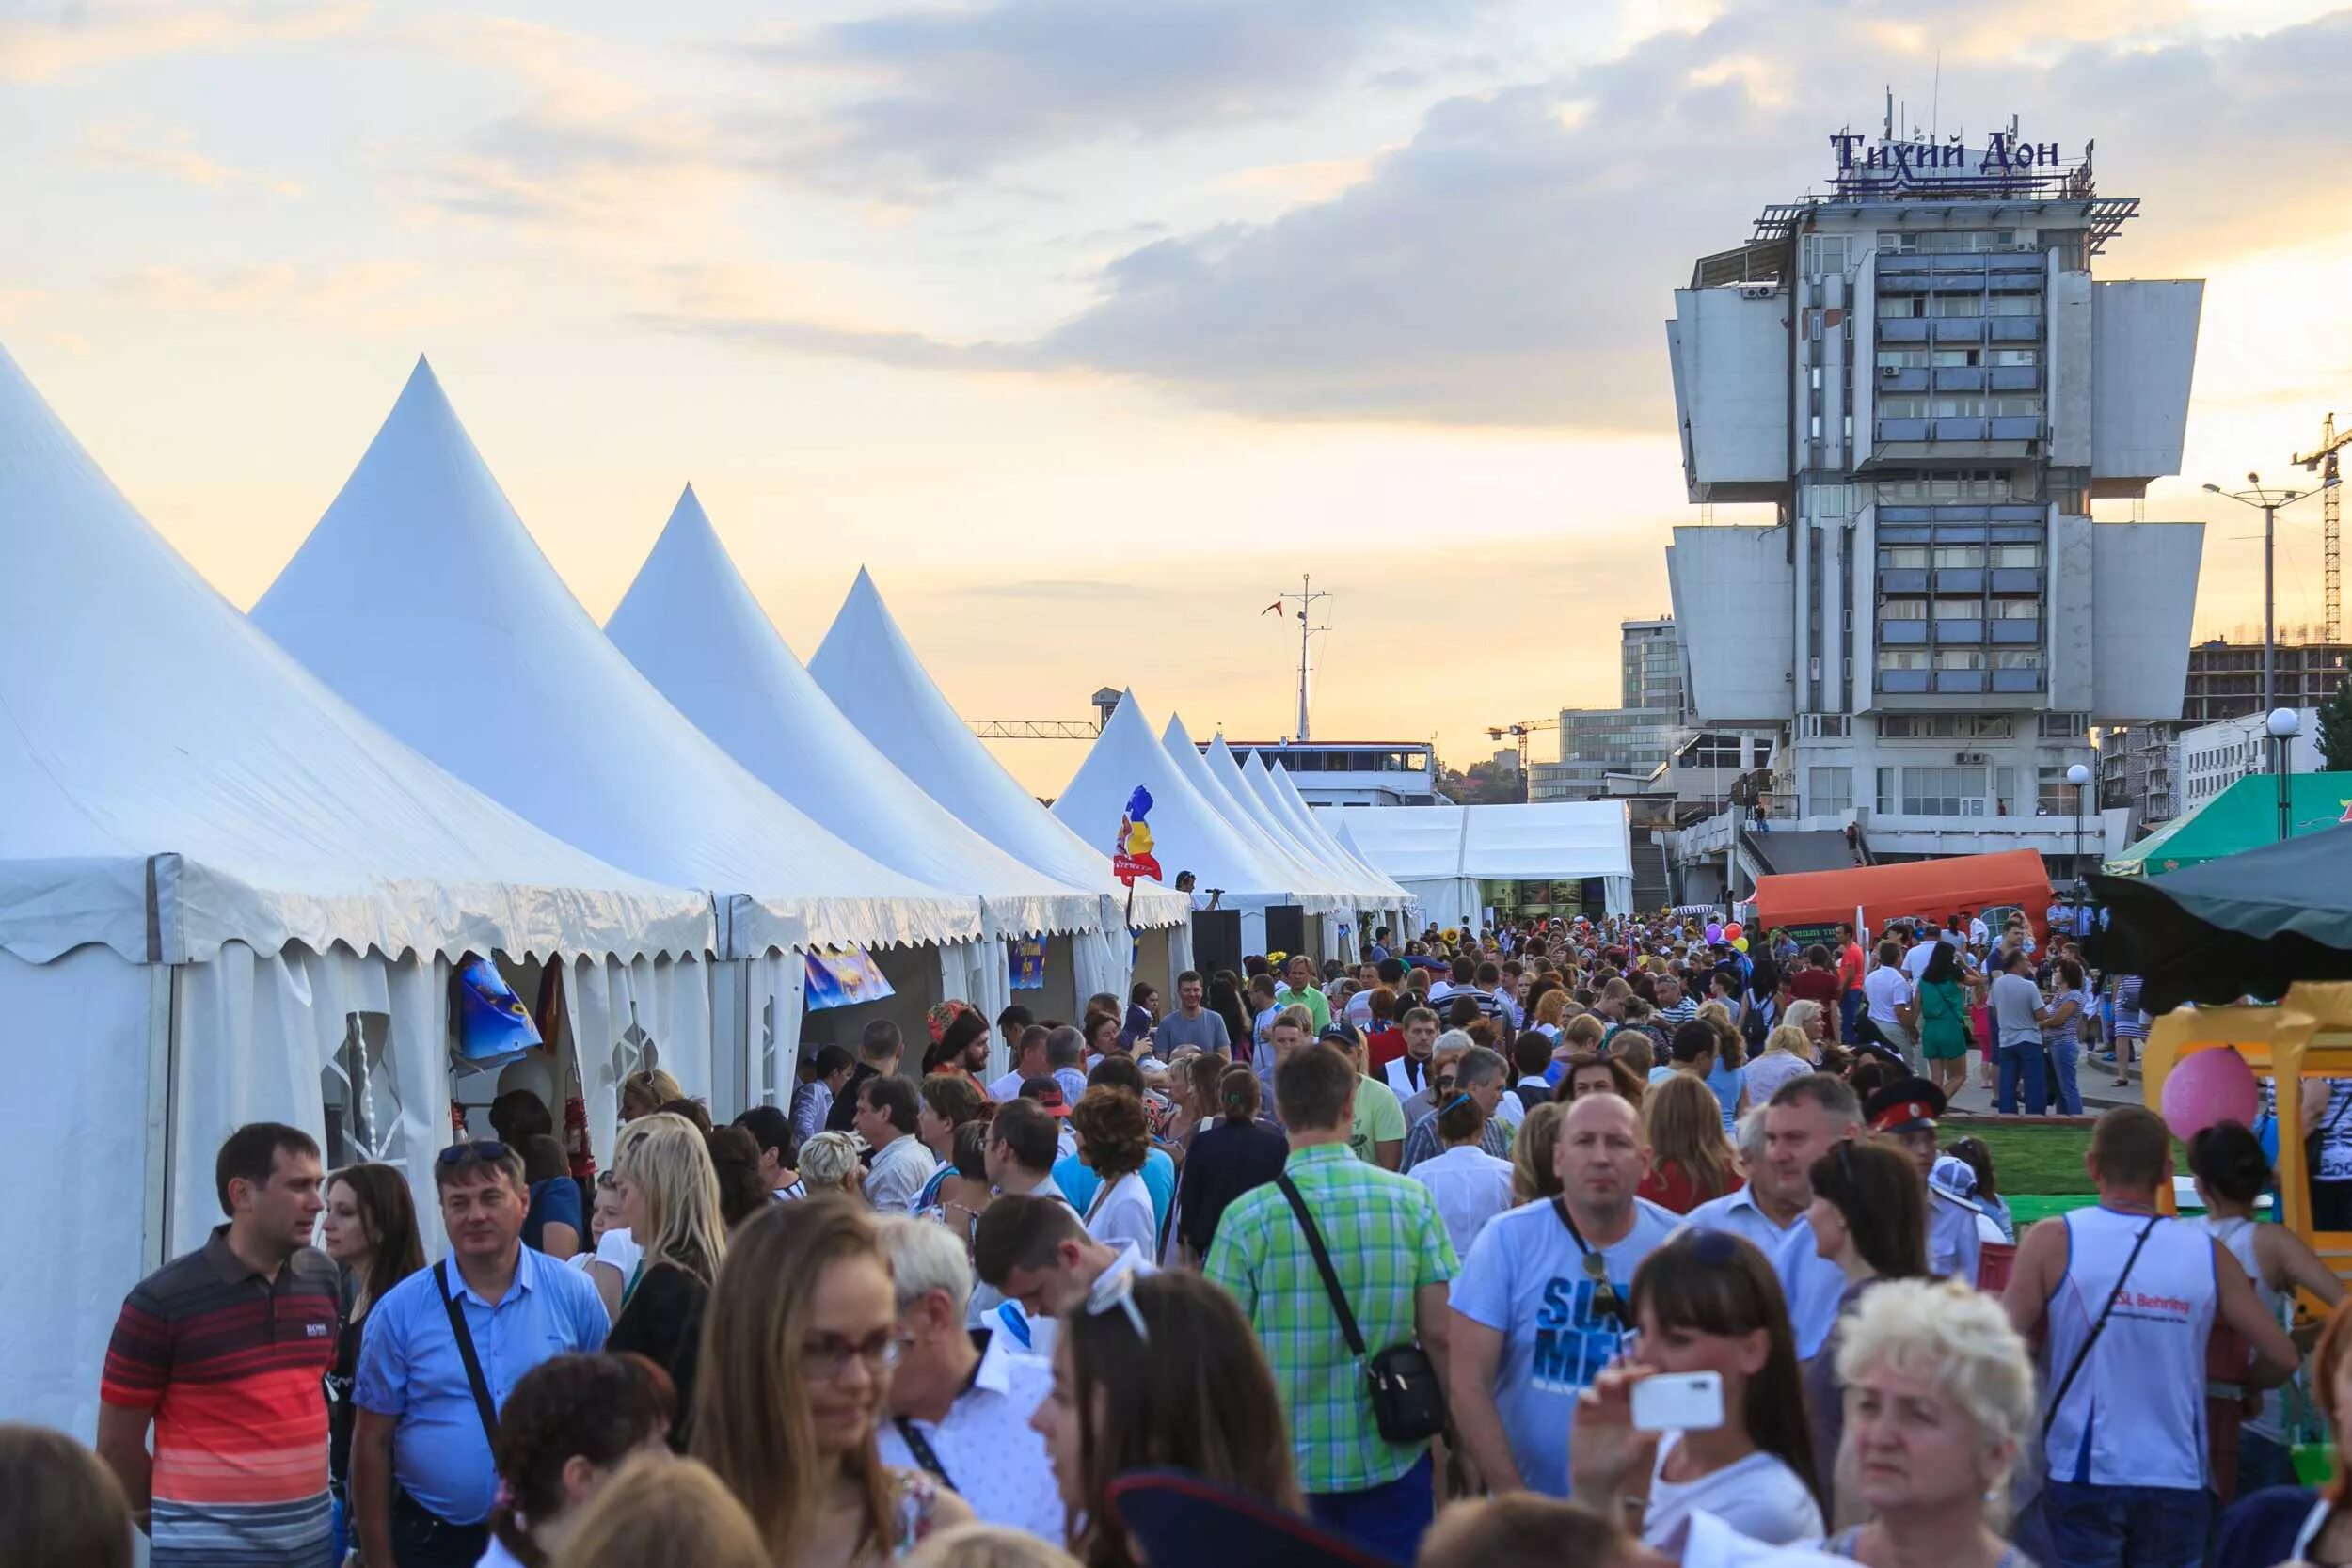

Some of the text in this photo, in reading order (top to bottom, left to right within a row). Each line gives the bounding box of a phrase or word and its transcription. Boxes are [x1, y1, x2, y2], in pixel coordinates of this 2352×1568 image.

[1830, 132, 2058, 182] Тихий Дон
[1537, 1277, 1629, 1329] SU
[2137, 1293, 2190, 1314] Behring
